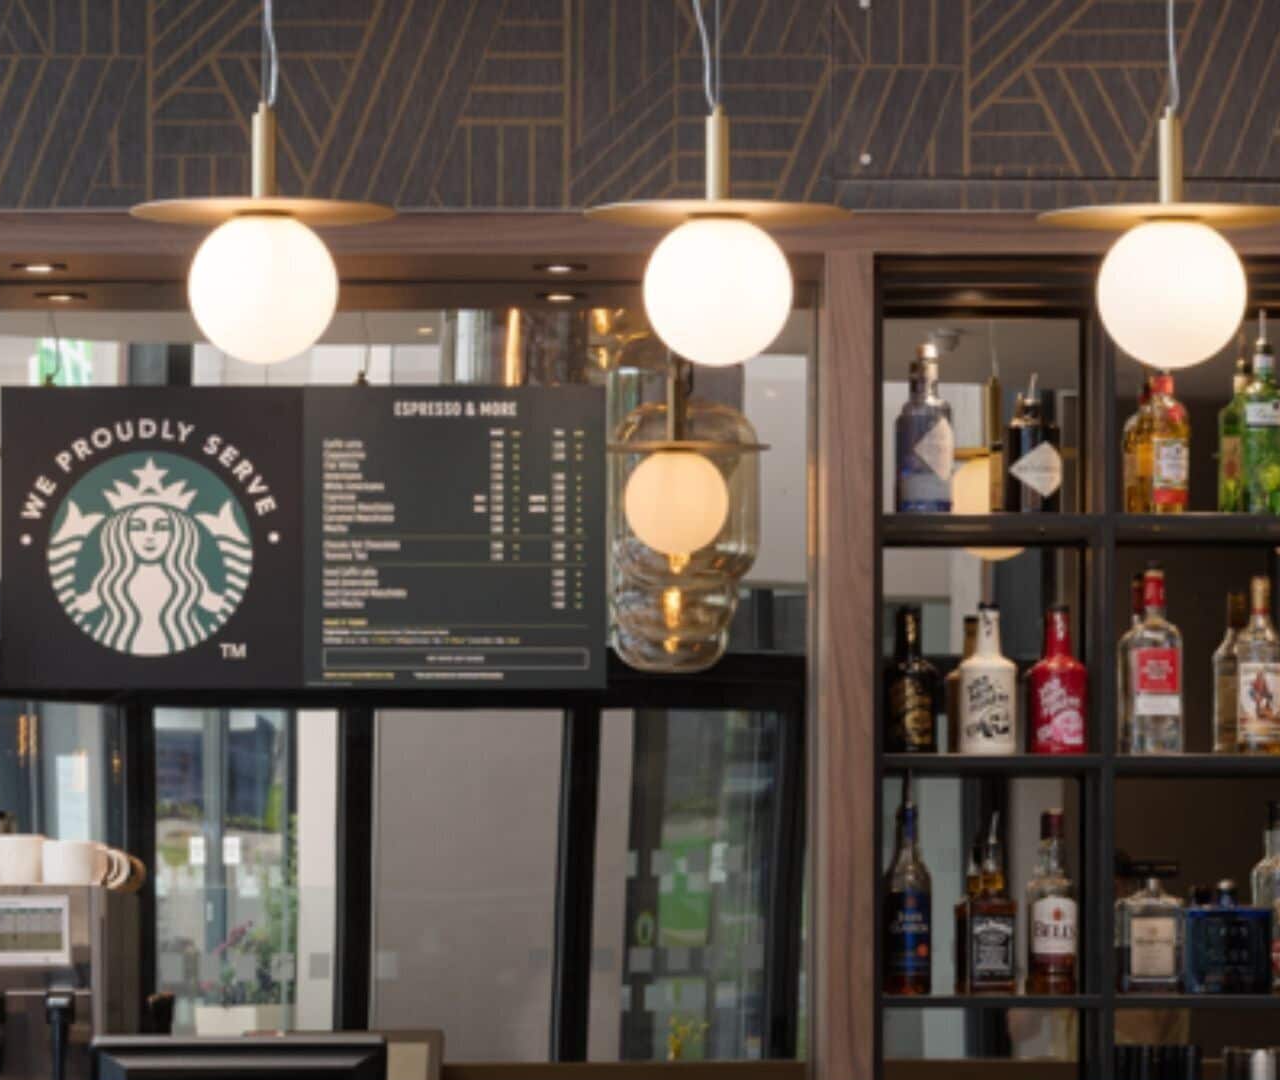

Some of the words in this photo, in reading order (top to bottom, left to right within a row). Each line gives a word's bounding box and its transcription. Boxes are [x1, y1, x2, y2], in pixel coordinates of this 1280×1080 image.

[393, 400, 462, 417] ESPRESSO
[464, 400, 475, 417] &
[480, 400, 517, 417] MORE
[21, 474, 57, 519] WE
[54, 417, 195, 472] PROUDLY
[202, 434, 277, 516] SERVE
[219, 642, 247, 659] TM
